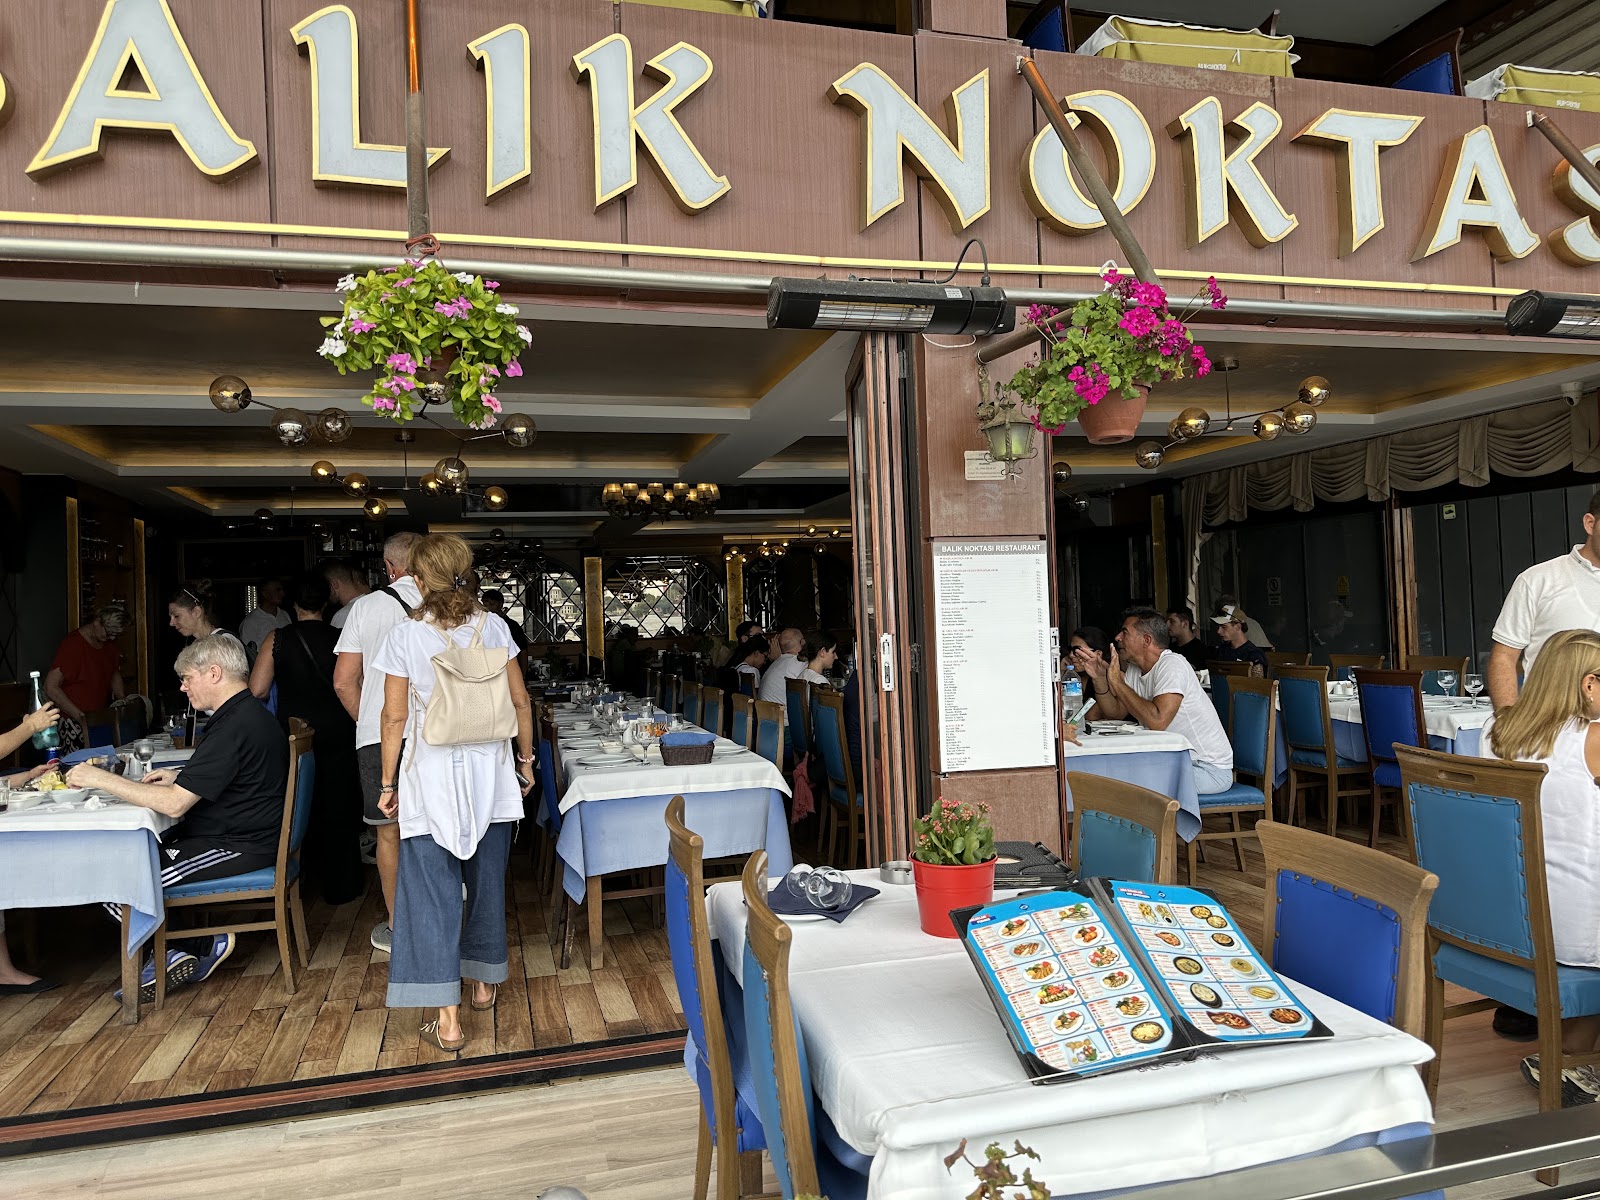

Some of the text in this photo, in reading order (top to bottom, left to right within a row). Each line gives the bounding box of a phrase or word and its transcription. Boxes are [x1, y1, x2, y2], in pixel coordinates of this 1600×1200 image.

[0, 0, 732, 214] ALIK
[941, 544, 1041, 553] BALIK NOKTASI RESTAURANT
